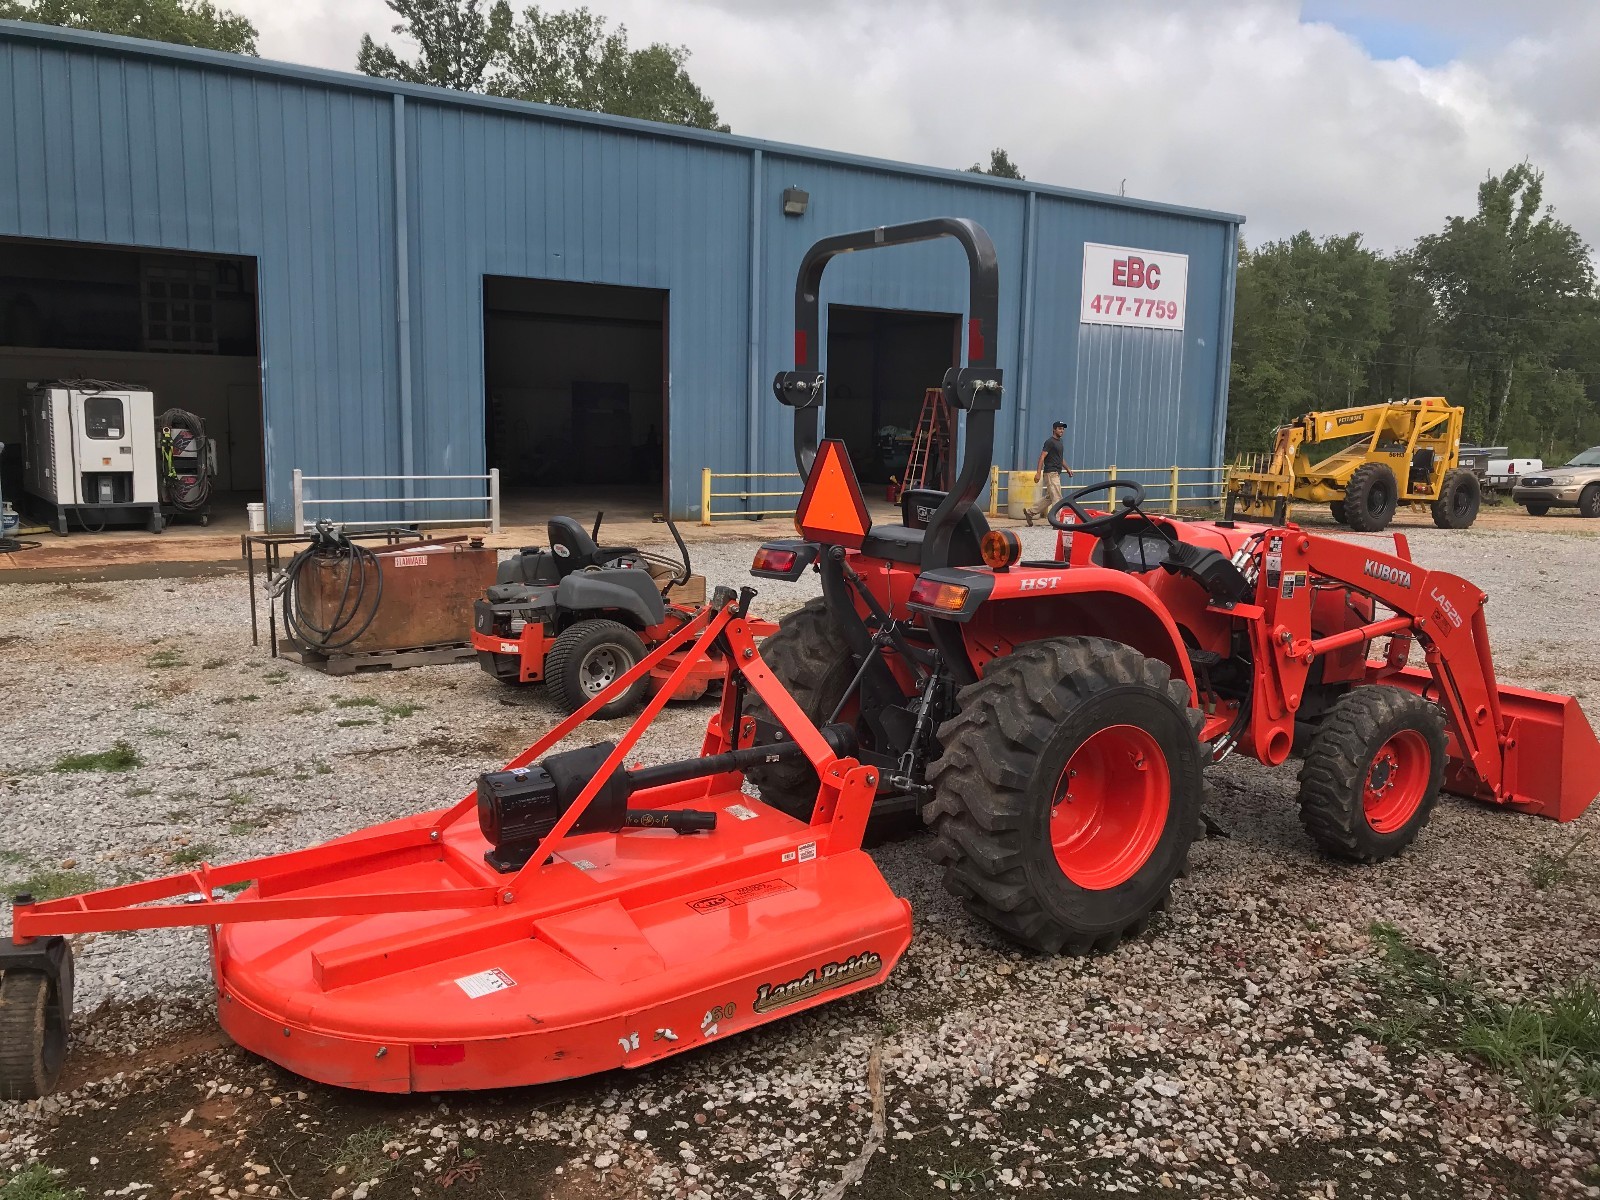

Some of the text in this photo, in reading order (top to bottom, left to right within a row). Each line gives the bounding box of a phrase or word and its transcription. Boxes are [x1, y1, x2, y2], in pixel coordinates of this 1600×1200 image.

[1112, 256, 1161, 290] EBC
[1090, 294, 1178, 320] 477-7759
[1019, 576, 1062, 591] HST
[1364, 559, 1411, 589] KUBOTA
[1431, 586, 1463, 628] LA525
[756, 951, 882, 1003] Land Pride
